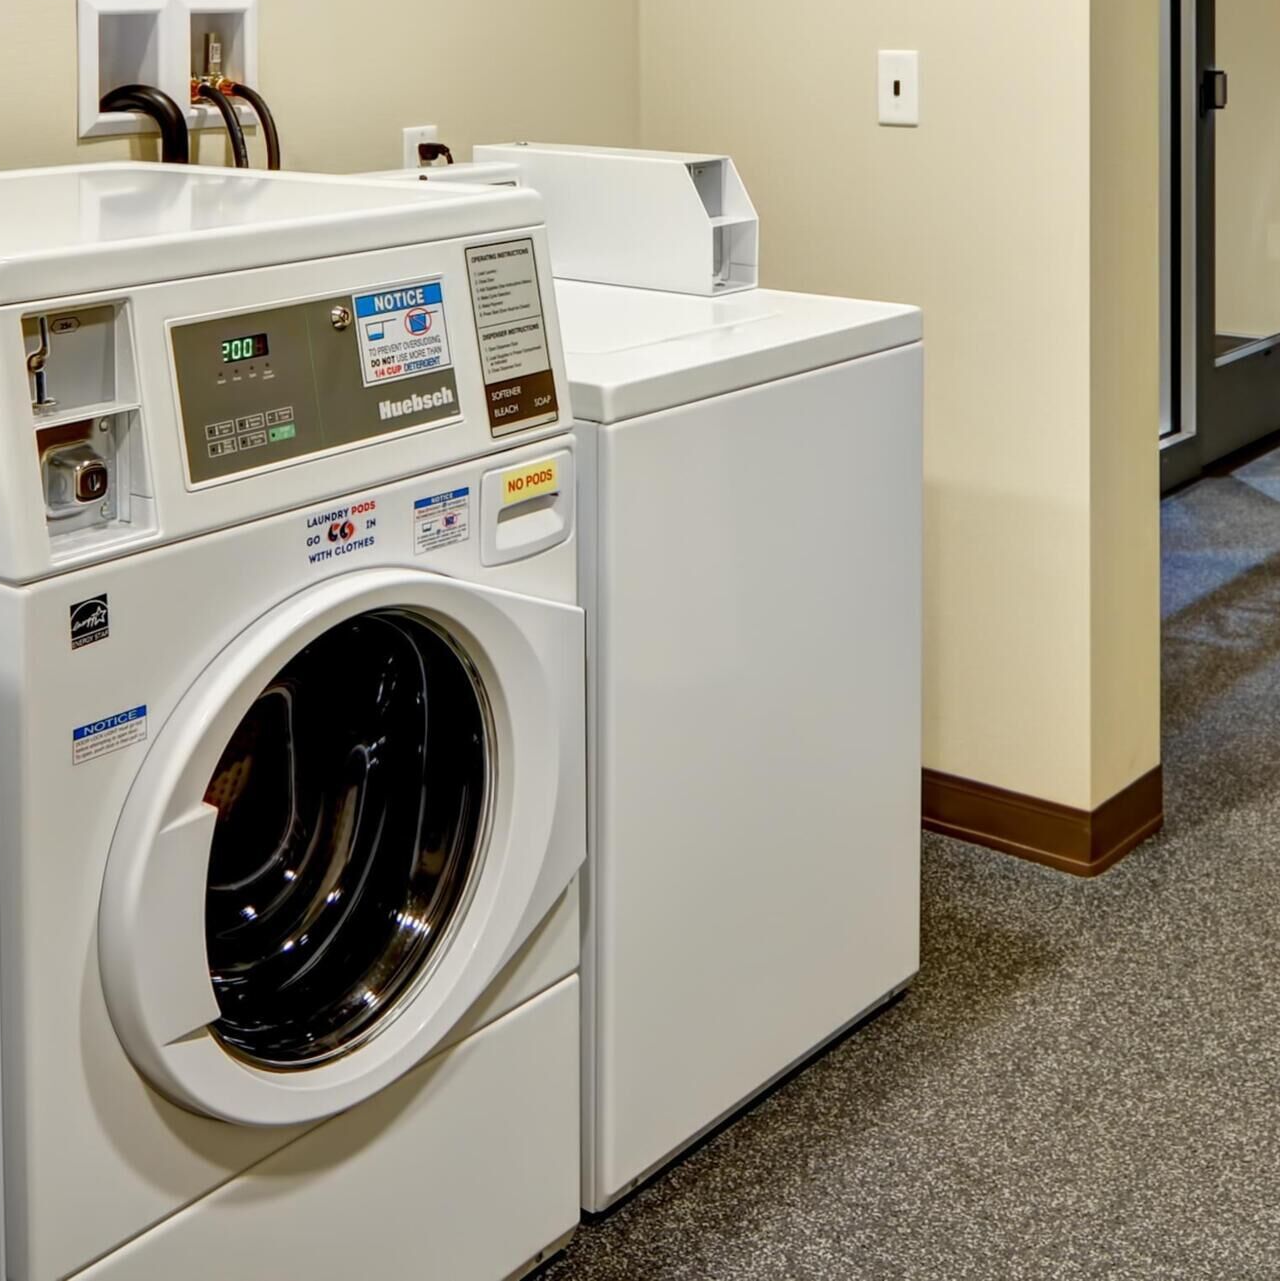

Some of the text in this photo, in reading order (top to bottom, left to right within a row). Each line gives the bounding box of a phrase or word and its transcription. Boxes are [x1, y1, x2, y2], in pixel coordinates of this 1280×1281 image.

[374, 288, 424, 312] NOTICE
[368, 347, 377, 357] TO
[378, 342, 402, 354] PREVENT
[371, 345, 442, 368] DO NOT USE MORE THAN
[375, 355, 440, 378] 1/4 CUP DETERGENT
[378, 386, 454, 420] Huebsch
[491, 385, 522, 401] SOFTENER
[494, 395, 552, 418] BLEACH SOAP
[508, 468, 552, 493] NO PODS
[307, 501, 376, 528] LAUNDRY PODS
[306, 518, 376, 547] GO IN
[308, 536, 375, 564] WITH CLOTHES
[84, 710, 137, 736] NOTICE
